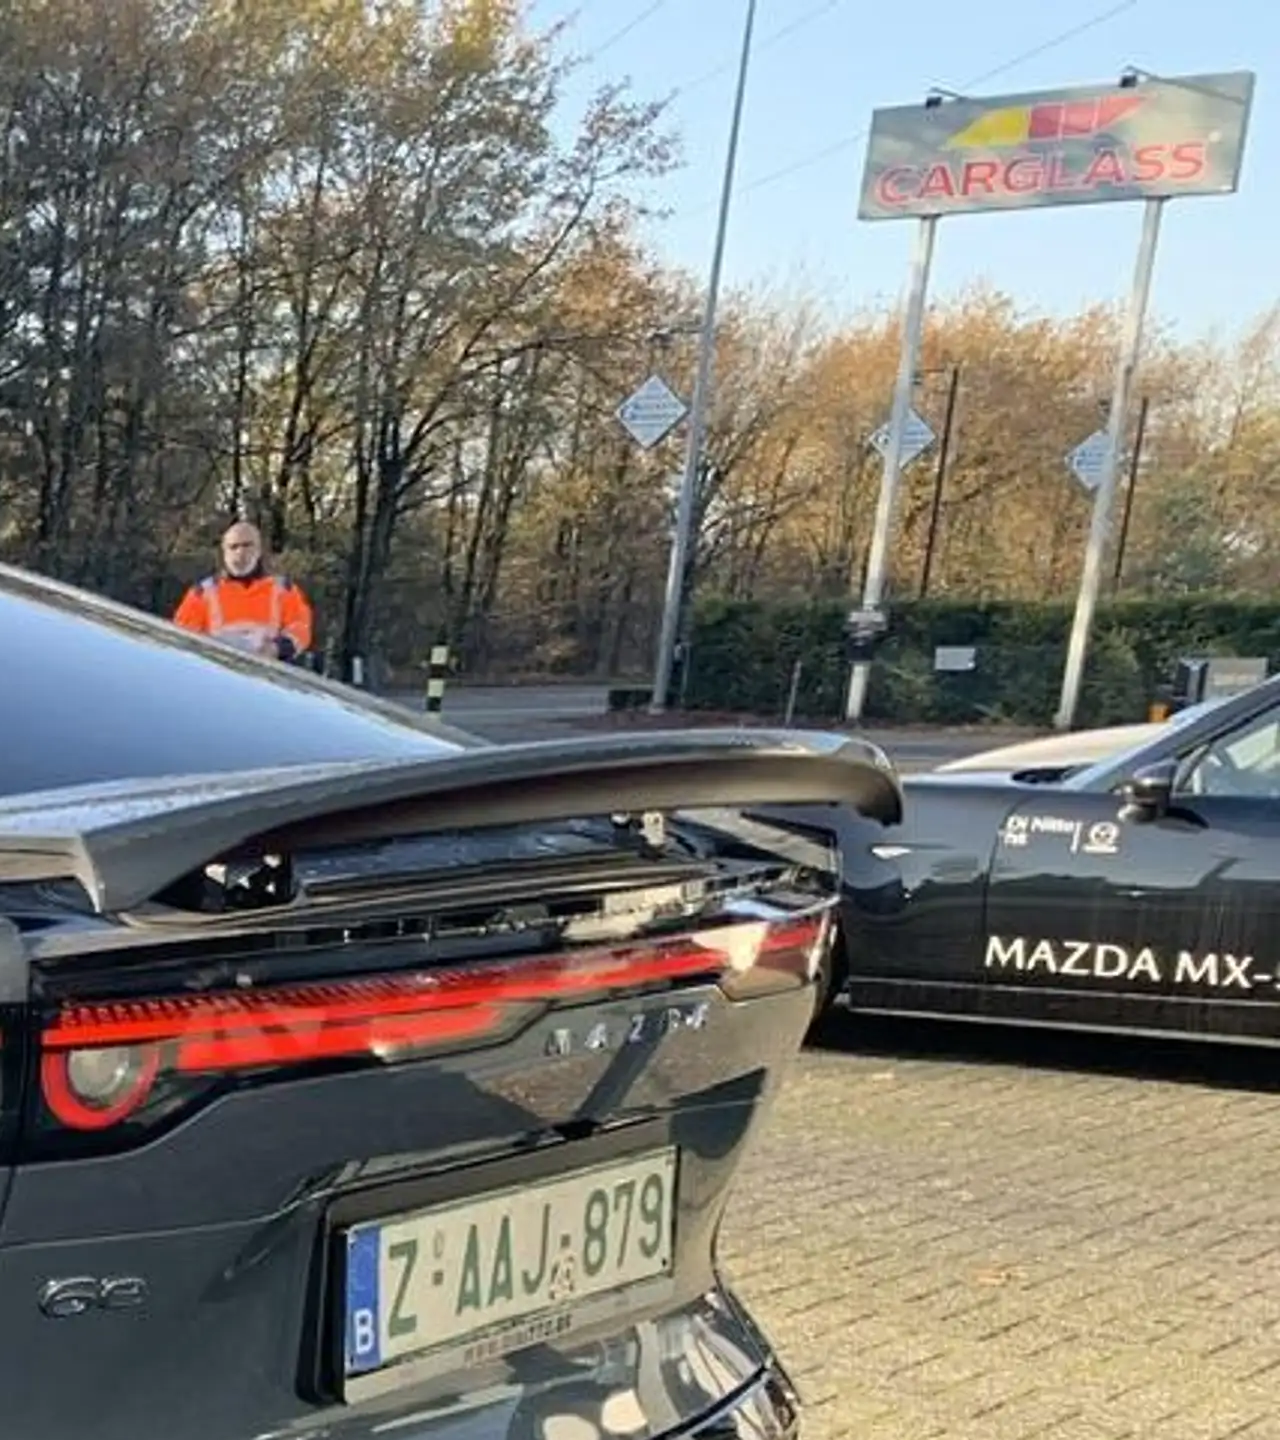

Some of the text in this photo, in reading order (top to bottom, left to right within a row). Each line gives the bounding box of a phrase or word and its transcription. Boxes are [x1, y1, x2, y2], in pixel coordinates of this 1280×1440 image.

[876, 141, 1207, 206] CARGLASS
[985, 935, 1280, 990] MAZDA MX-
[353, 1308, 375, 1354] B
